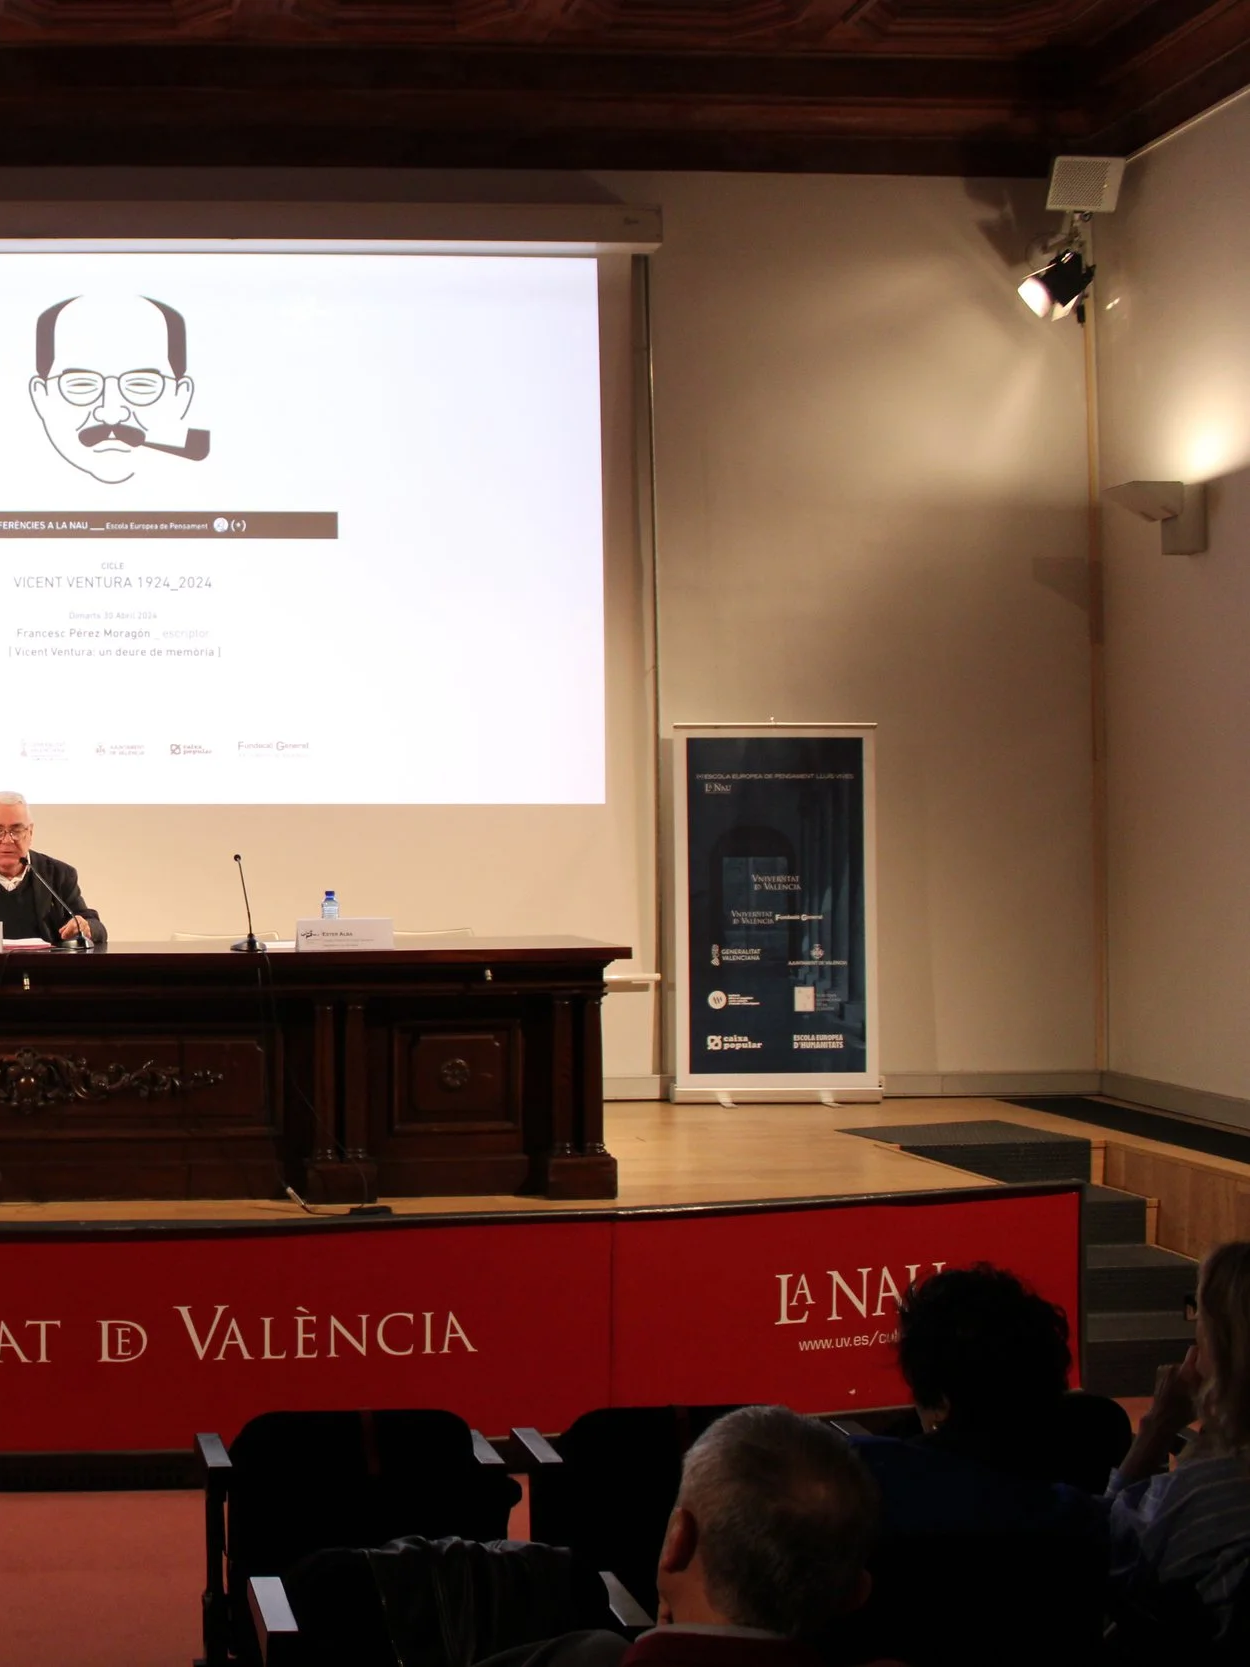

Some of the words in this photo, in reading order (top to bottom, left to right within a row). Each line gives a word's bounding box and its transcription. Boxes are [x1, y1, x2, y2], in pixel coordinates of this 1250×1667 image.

[48, 521, 54, 530] A
[56, 521, 67, 530] LA
[69, 521, 88, 530] NAU
[106, 522, 128, 530] Escola
[130, 522, 158, 532] Europea
[160, 522, 168, 530] de
[170, 522, 208, 530] Pensament
[101, 562, 124, 570] CICLE
[14, 576, 63, 589] VICENT
[67, 576, 133, 589] VENTURA
[138, 576, 213, 592] 1924_2024
[16, 628, 66, 638] Francesc
[69, 628, 100, 638] Pérez
[103, 628, 151, 640] Moragón
[15, 647, 48, 657] Vicent
[99, 649, 112, 657] un
[115, 647, 147, 657] deure
[150, 647, 163, 657] de
[166, 647, 215, 657] memòria
[723, 1041, 762, 1049] popular
[826, 1261, 947, 1321] NA
[174, 1305, 478, 1361] VALÈNCIA
